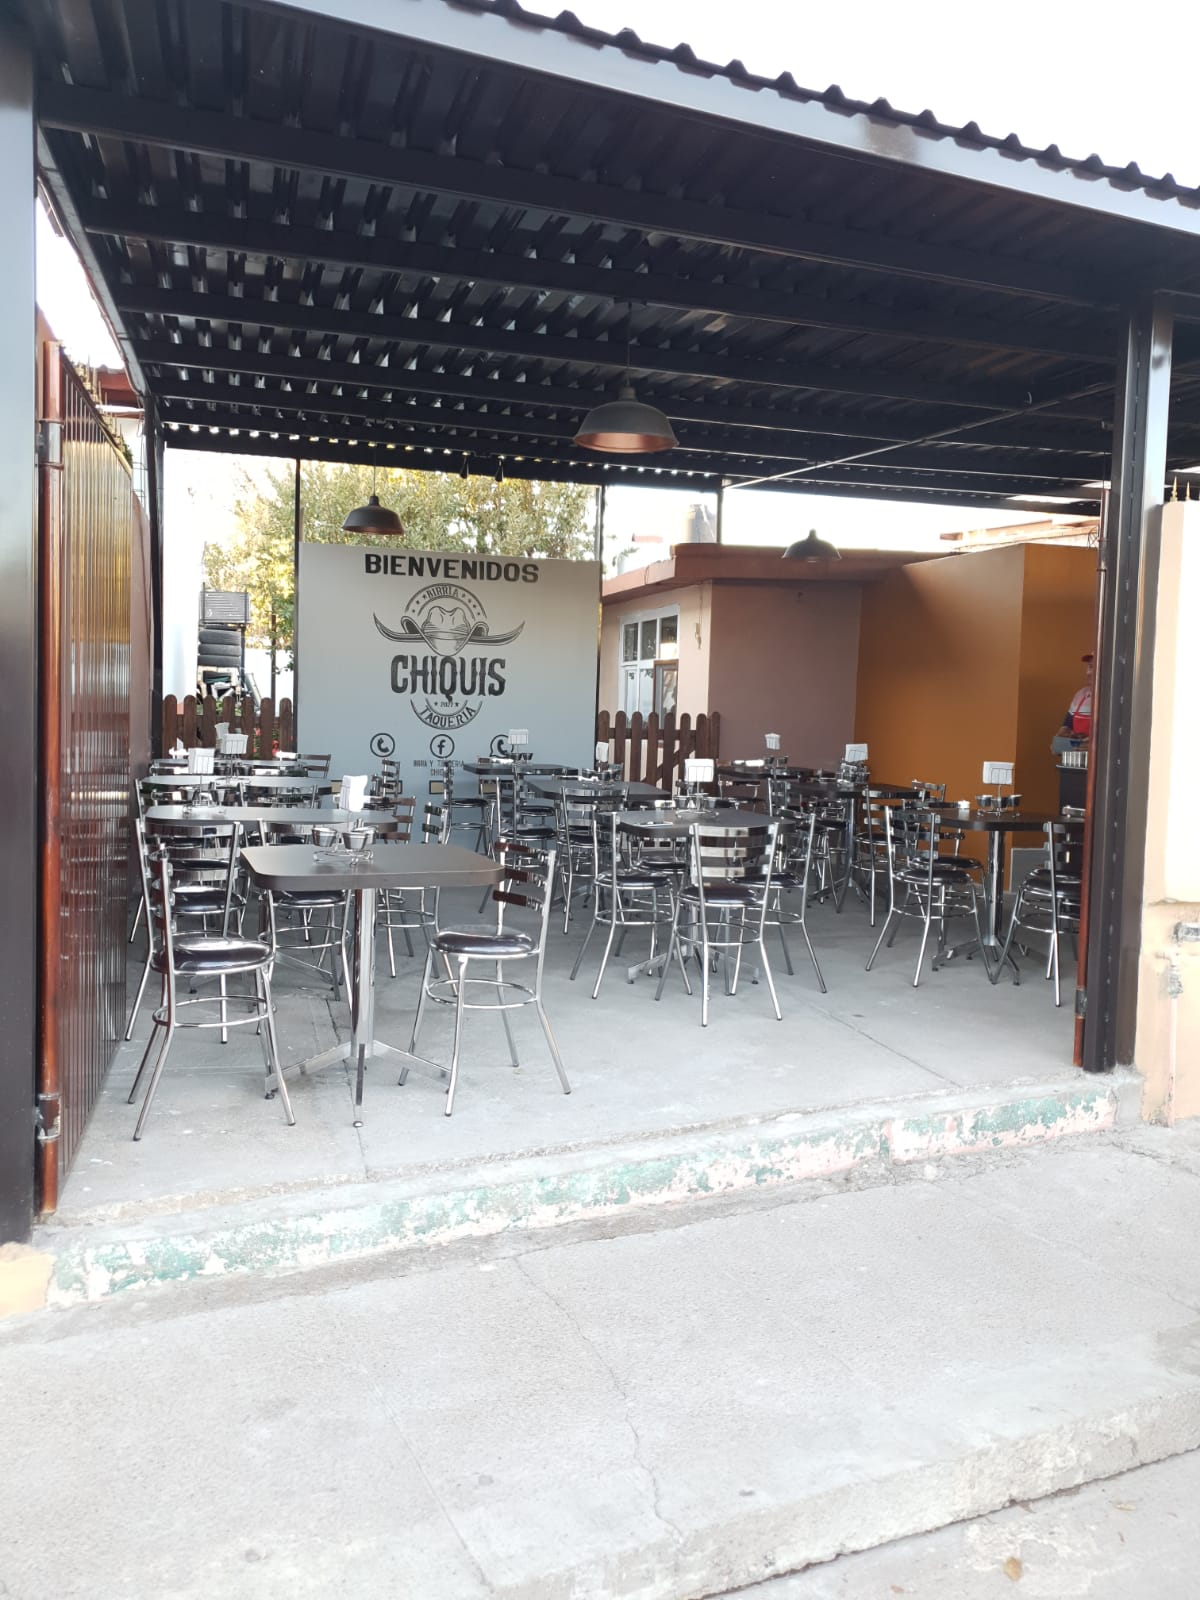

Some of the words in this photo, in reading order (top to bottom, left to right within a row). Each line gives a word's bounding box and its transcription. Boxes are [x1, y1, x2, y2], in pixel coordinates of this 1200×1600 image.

[365, 553, 539, 583] BIENVENIDOS
[426, 585, 459, 599] BIRRIA
[391, 654, 506, 702] CHIQUIS
[420, 705, 476, 728] TAQUERIA
